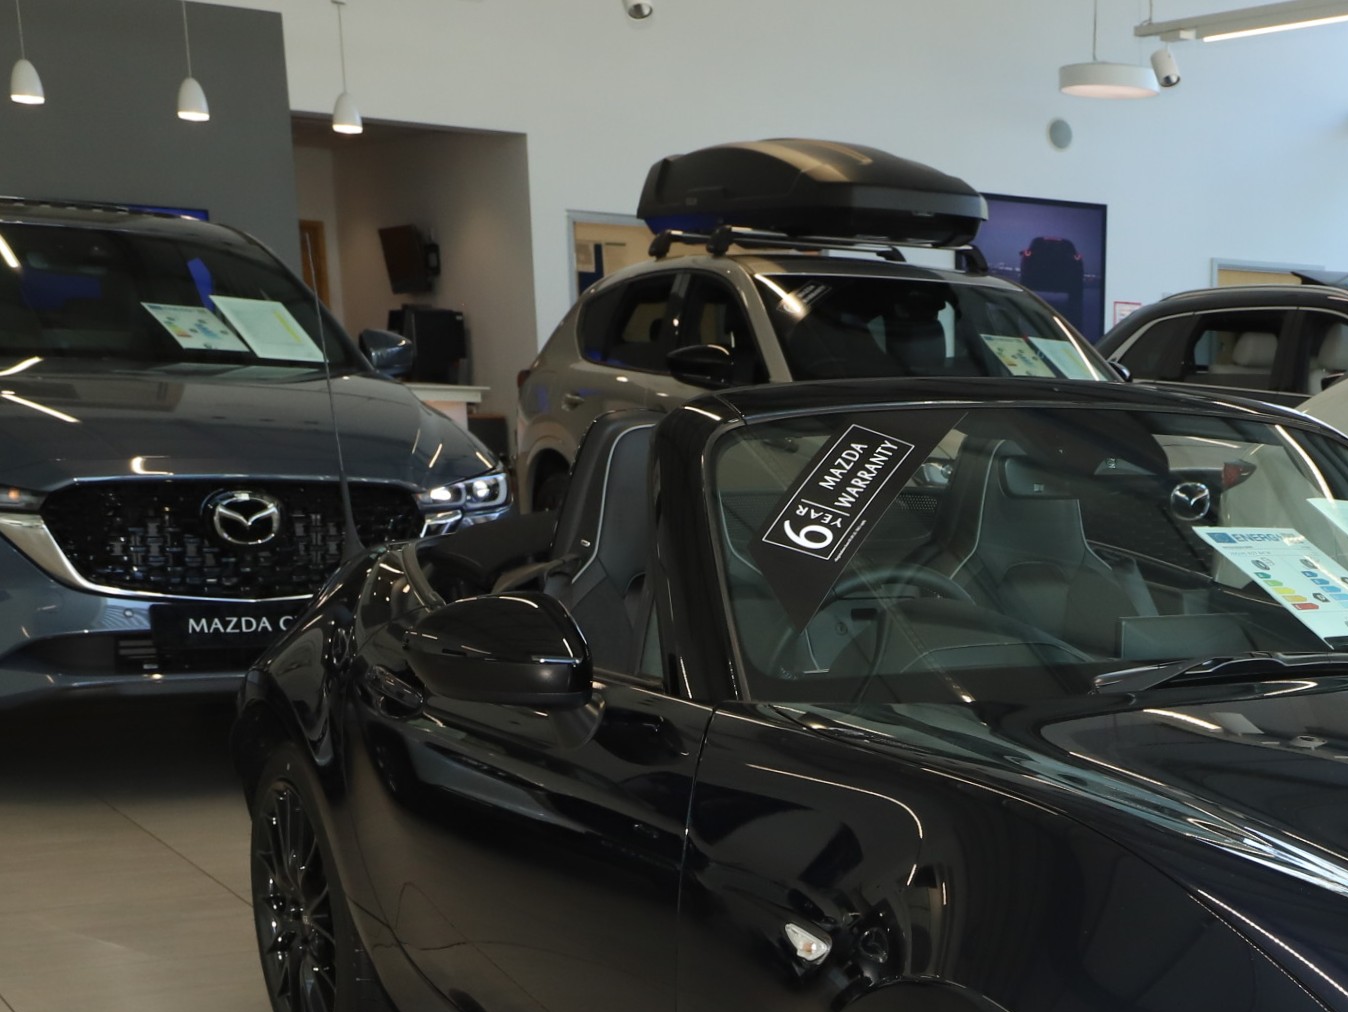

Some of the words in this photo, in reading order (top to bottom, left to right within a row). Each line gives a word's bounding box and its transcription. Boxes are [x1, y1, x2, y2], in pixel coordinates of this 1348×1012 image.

[818, 442, 869, 491] MAZDA
[834, 439, 899, 508] WARRANTY
[795, 504, 842, 528] YEAR
[783, 519, 834, 550] 6
[188, 616, 273, 634] MAZDA
[279, 615, 298, 631] C
